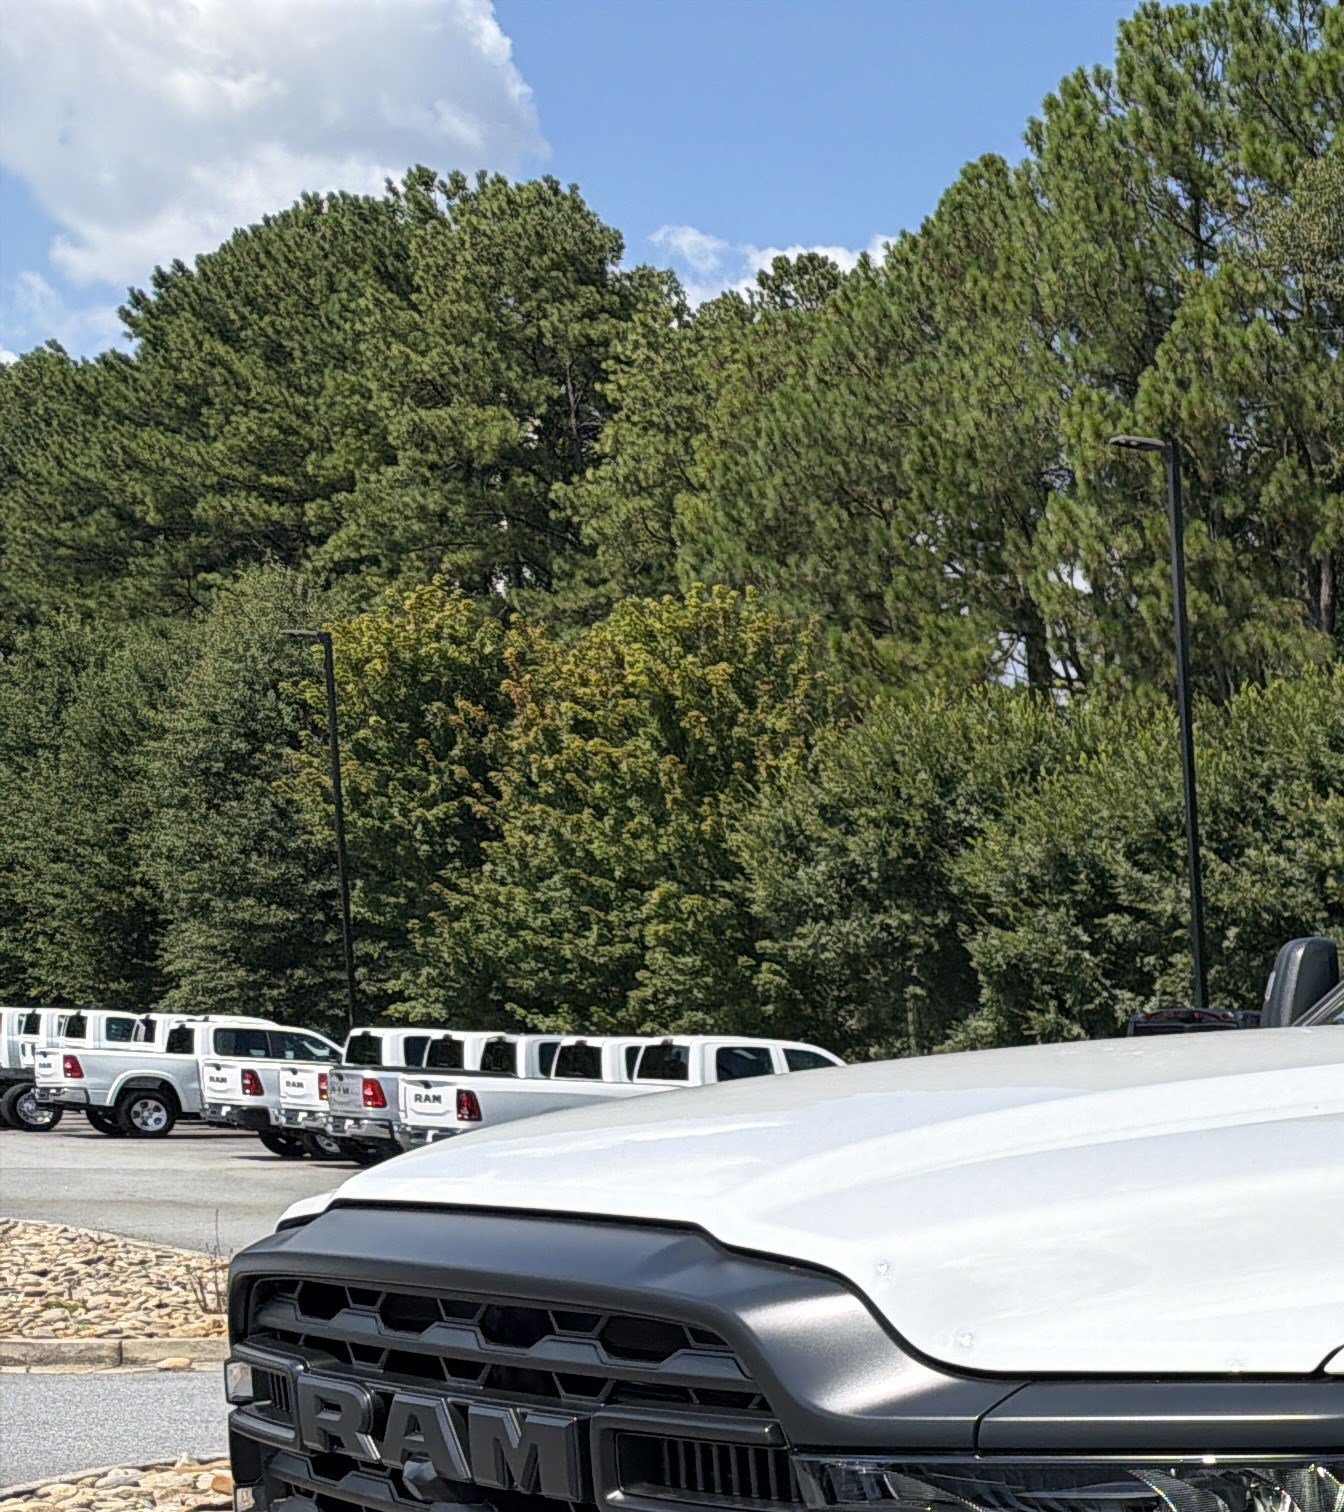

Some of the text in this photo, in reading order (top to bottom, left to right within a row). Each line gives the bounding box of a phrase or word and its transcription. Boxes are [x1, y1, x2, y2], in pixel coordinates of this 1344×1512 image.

[209, 1076, 228, 1084] RAM
[285, 1080, 304, 1089] RAM
[414, 1093, 443, 1104] RAM
[297, 1372, 583, 1502] RAM
